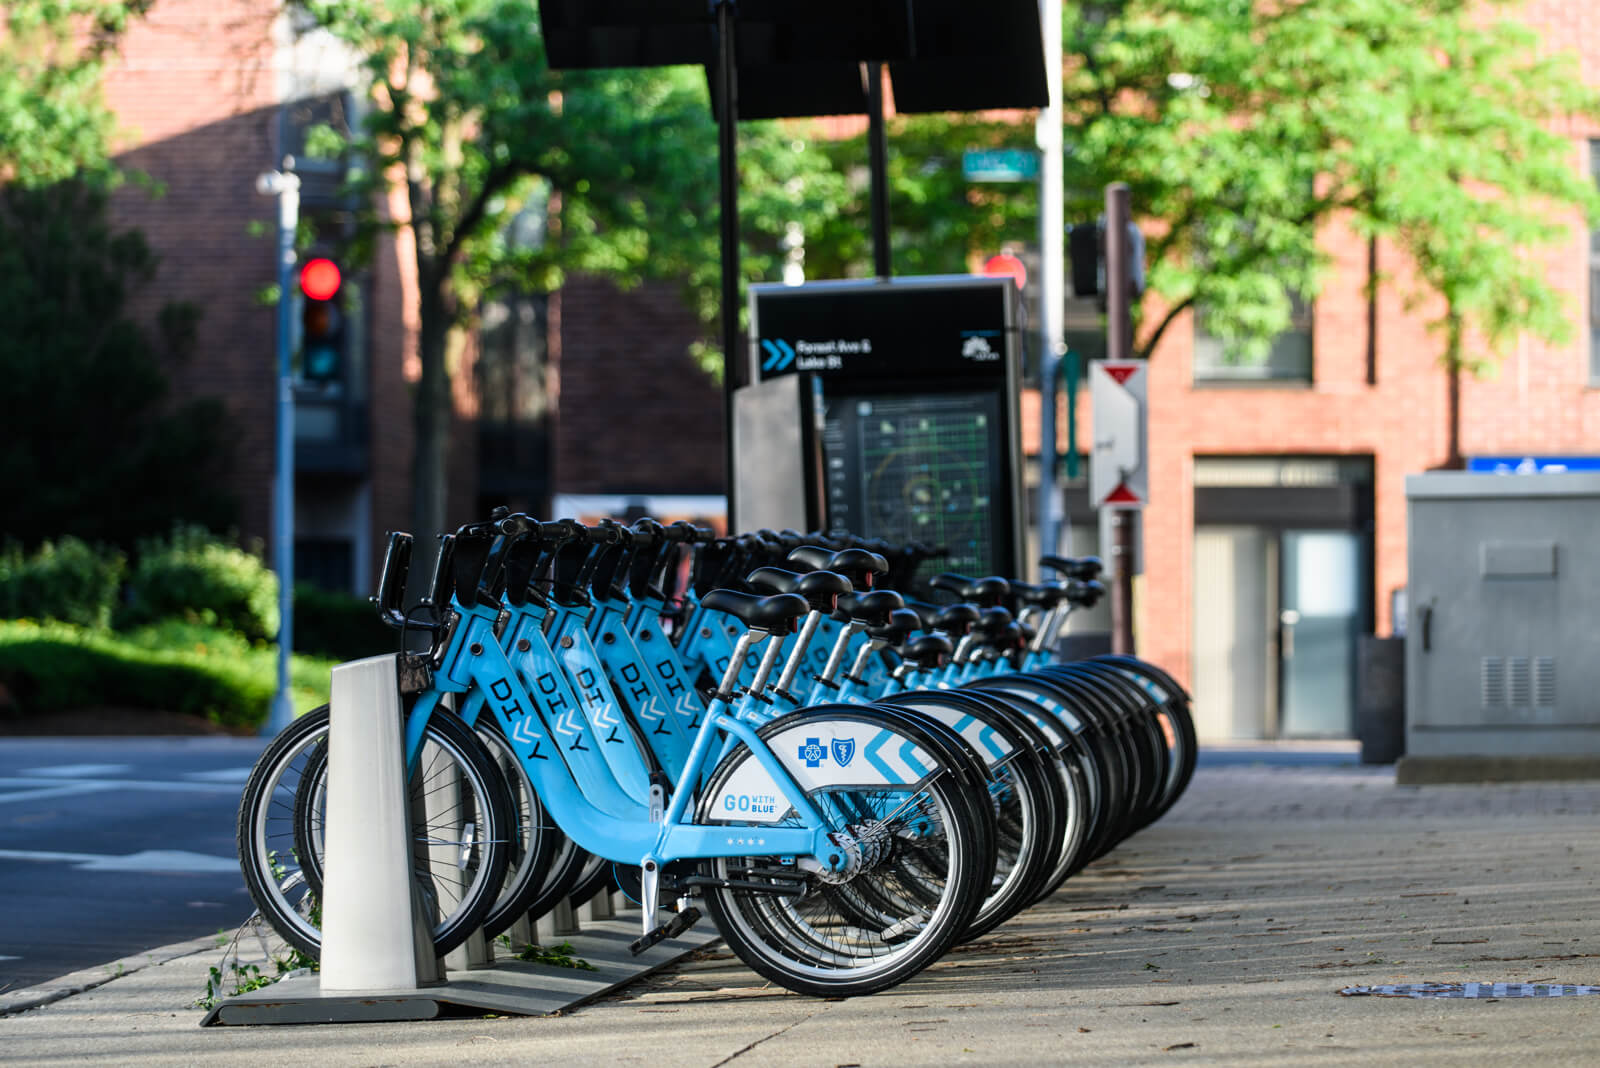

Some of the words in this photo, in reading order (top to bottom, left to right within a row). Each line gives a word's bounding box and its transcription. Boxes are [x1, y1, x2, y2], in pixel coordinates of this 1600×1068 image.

[724, 794, 750, 812] GO
[752, 795, 775, 804] WITH
[752, 804, 775, 813] BLUE
